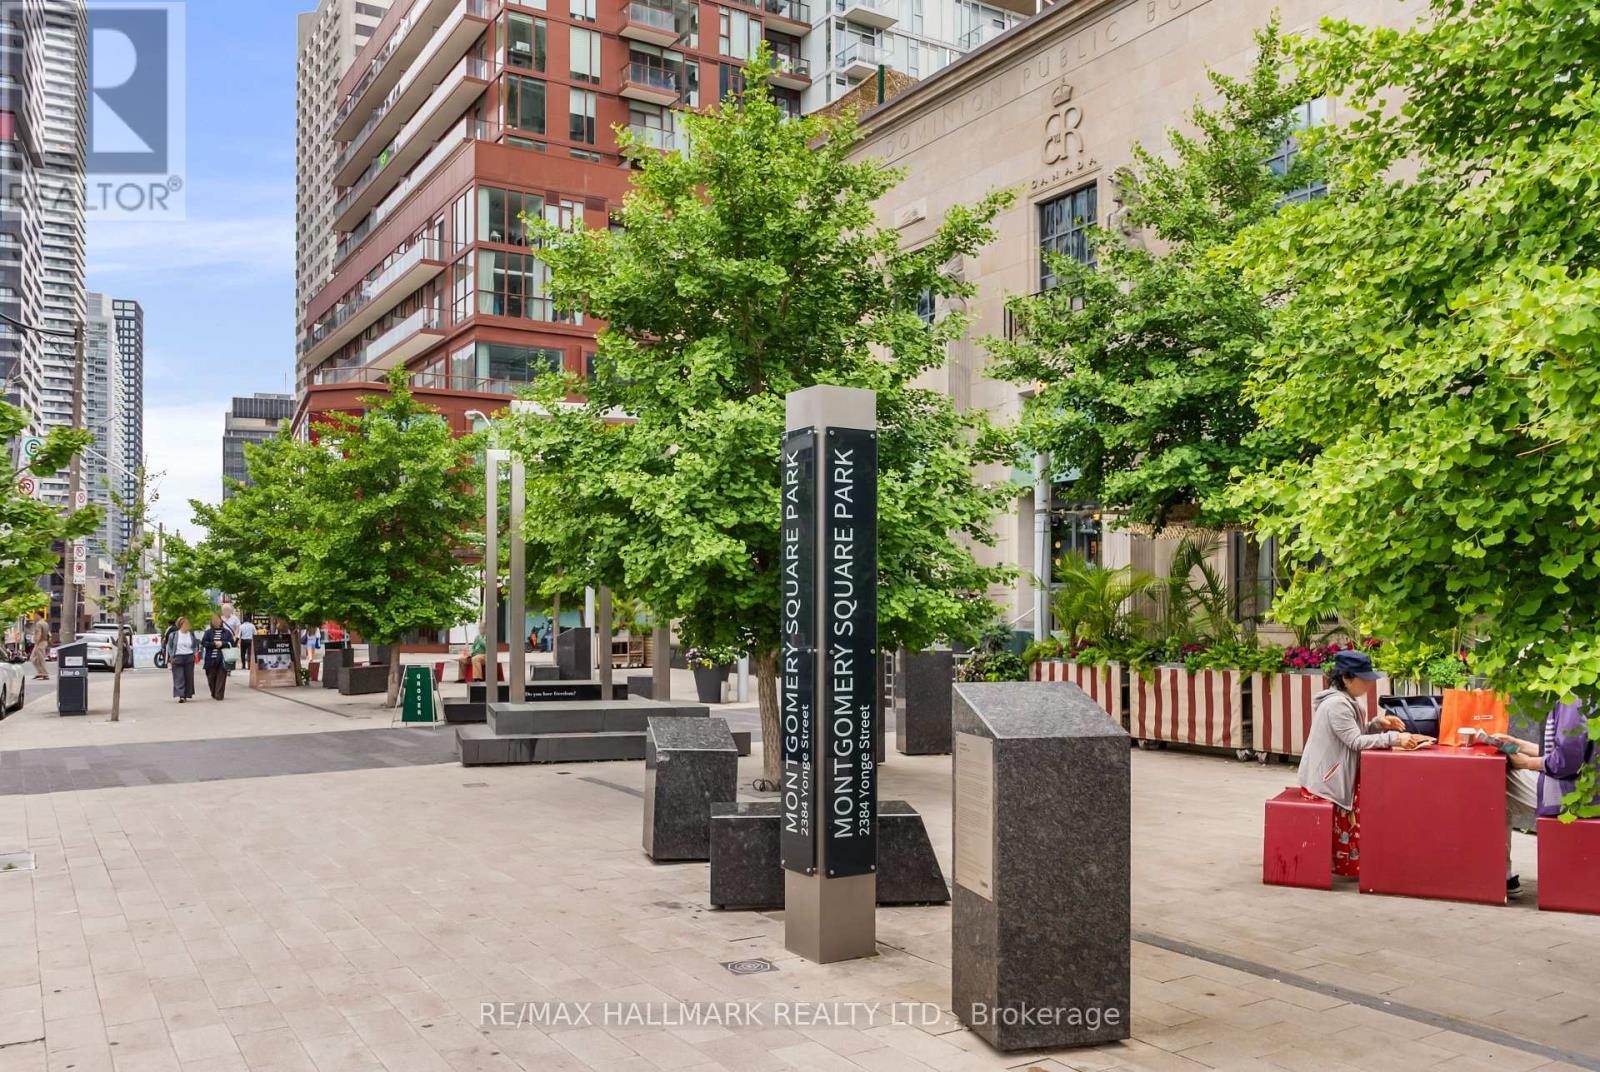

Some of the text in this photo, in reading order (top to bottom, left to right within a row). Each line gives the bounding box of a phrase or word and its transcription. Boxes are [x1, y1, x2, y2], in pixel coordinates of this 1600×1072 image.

[1022, 20, 1120, 88] PUBLIC
[1031, 158, 1097, 190] CANADA
[785, 449, 801, 833] MONTGOMERY SQUARE PARK
[833, 449, 858, 838] MONTGOMERY SQUARE PARK
[800, 703, 811, 836] 2384 Yonge Street
[858, 704, 873, 836] 2384 Yonge Street
